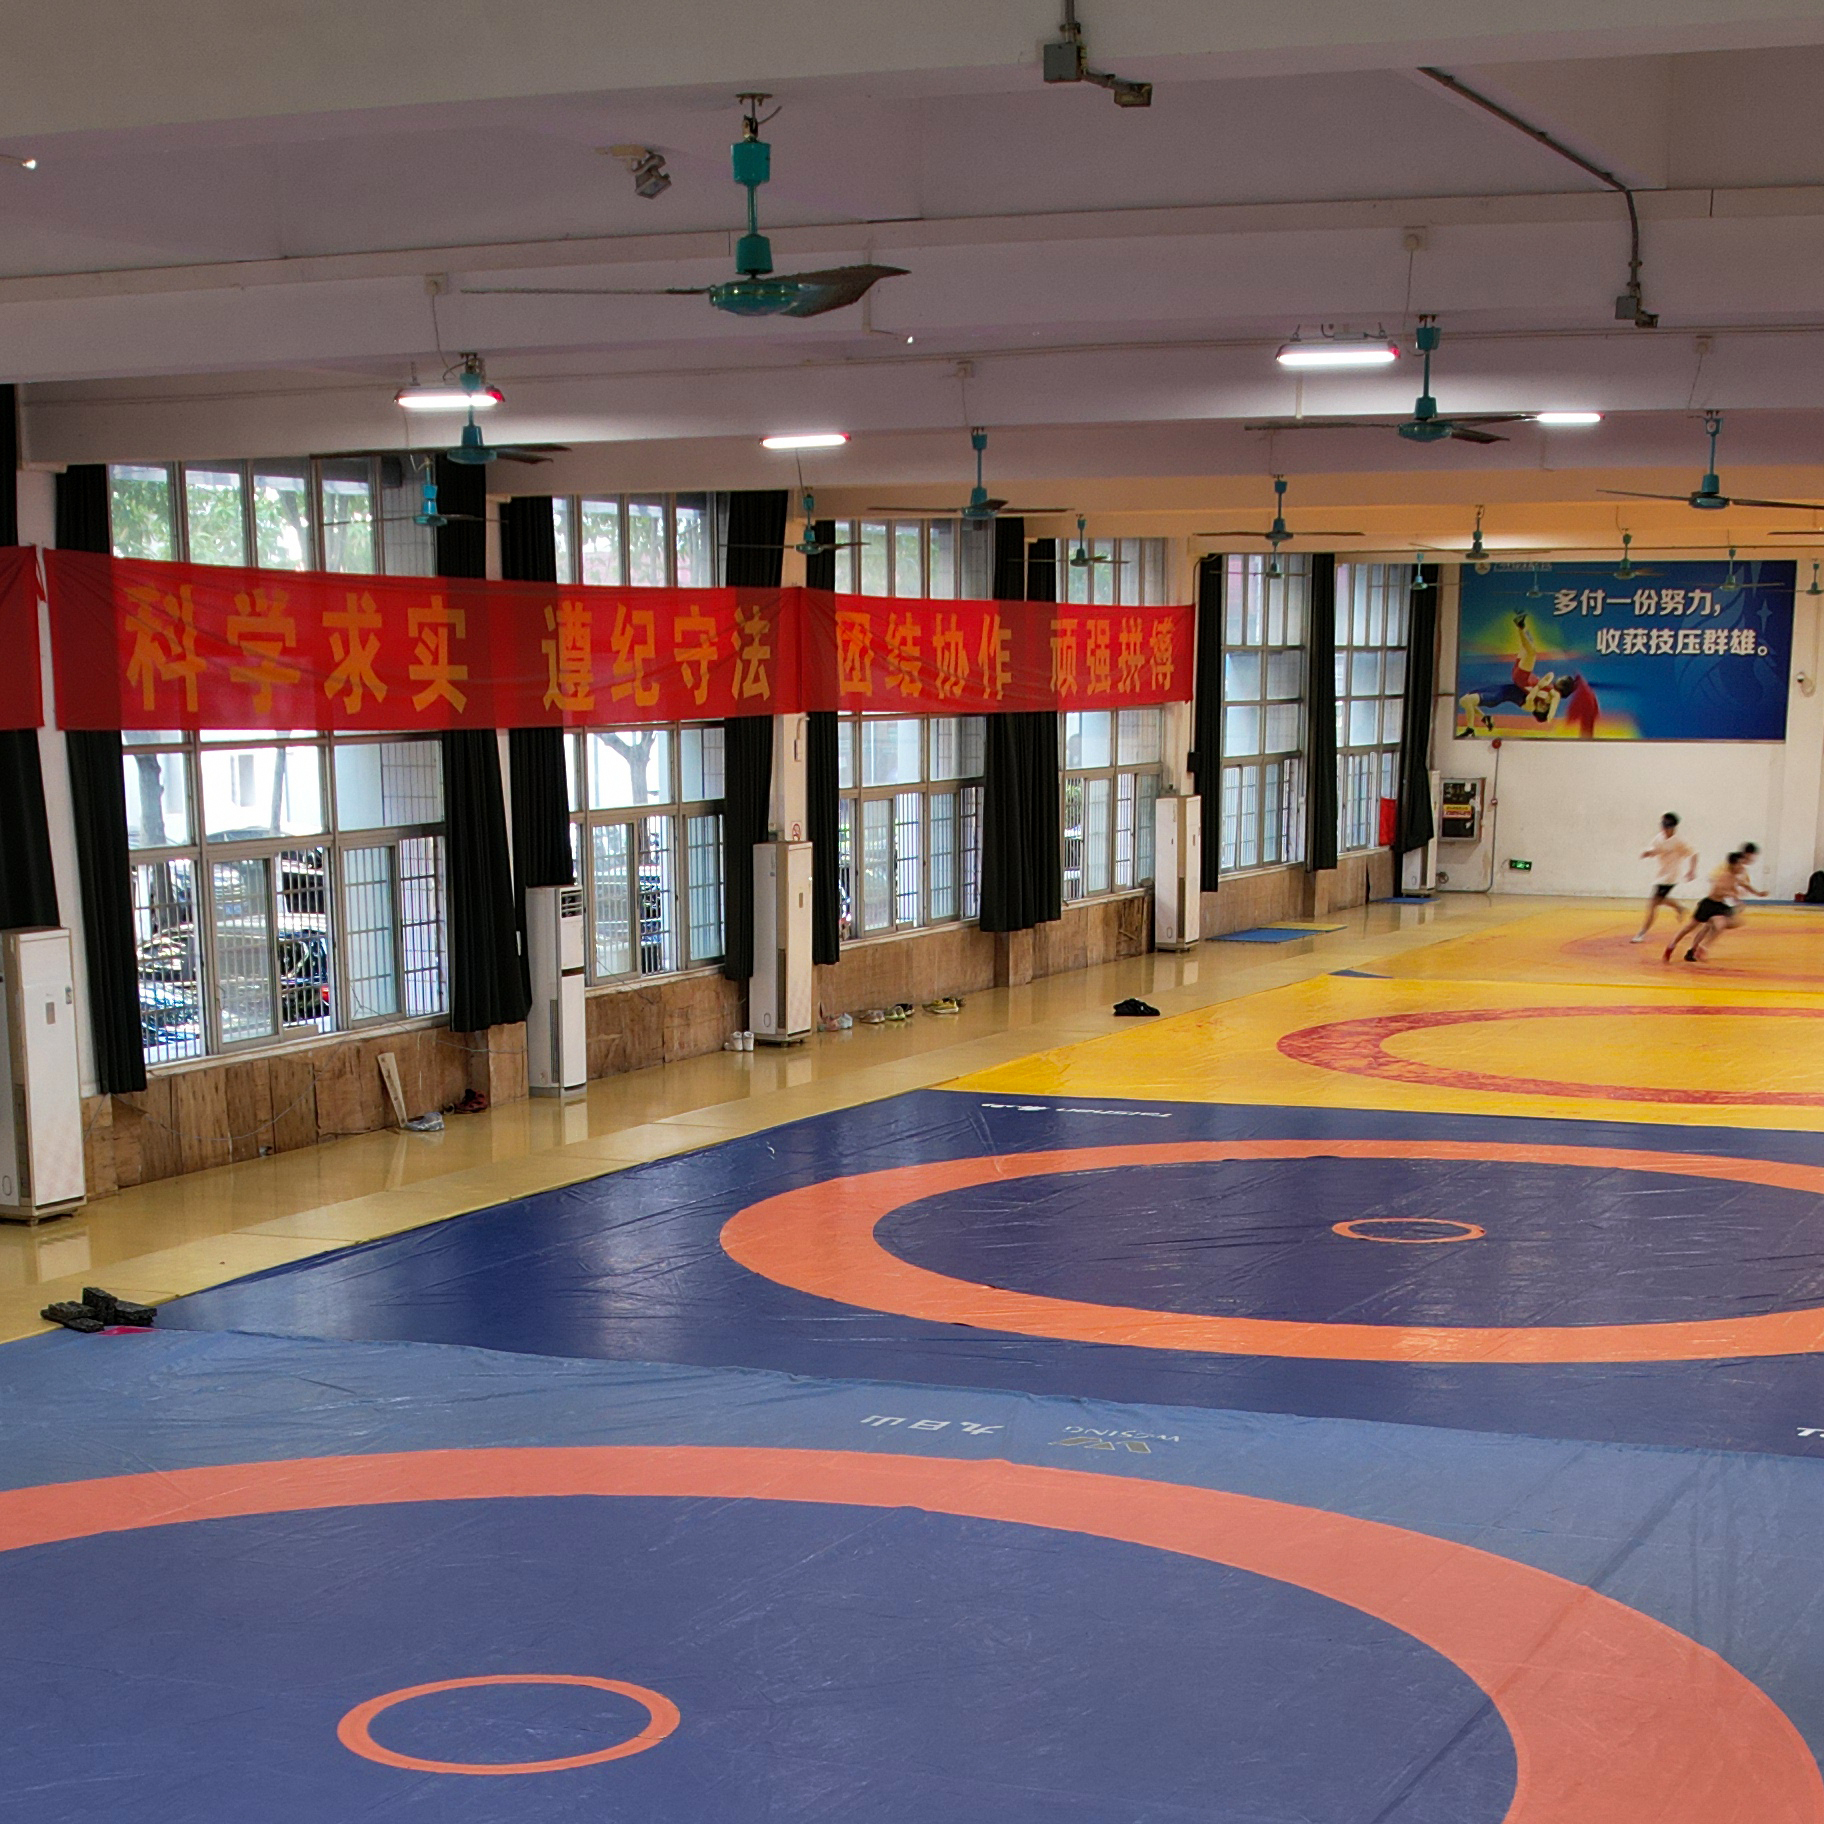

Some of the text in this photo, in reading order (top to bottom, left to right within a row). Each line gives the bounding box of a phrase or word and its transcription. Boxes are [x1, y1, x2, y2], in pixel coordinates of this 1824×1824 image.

[1553, 589, 1721, 616] 多付一份努力，
[123, 583, 771, 714] 科学求实 遵纪守法
[835, 612, 1174, 700] 团结协作 顽强拼搏
[1596, 628, 1768, 656] 收获技压群雄。
